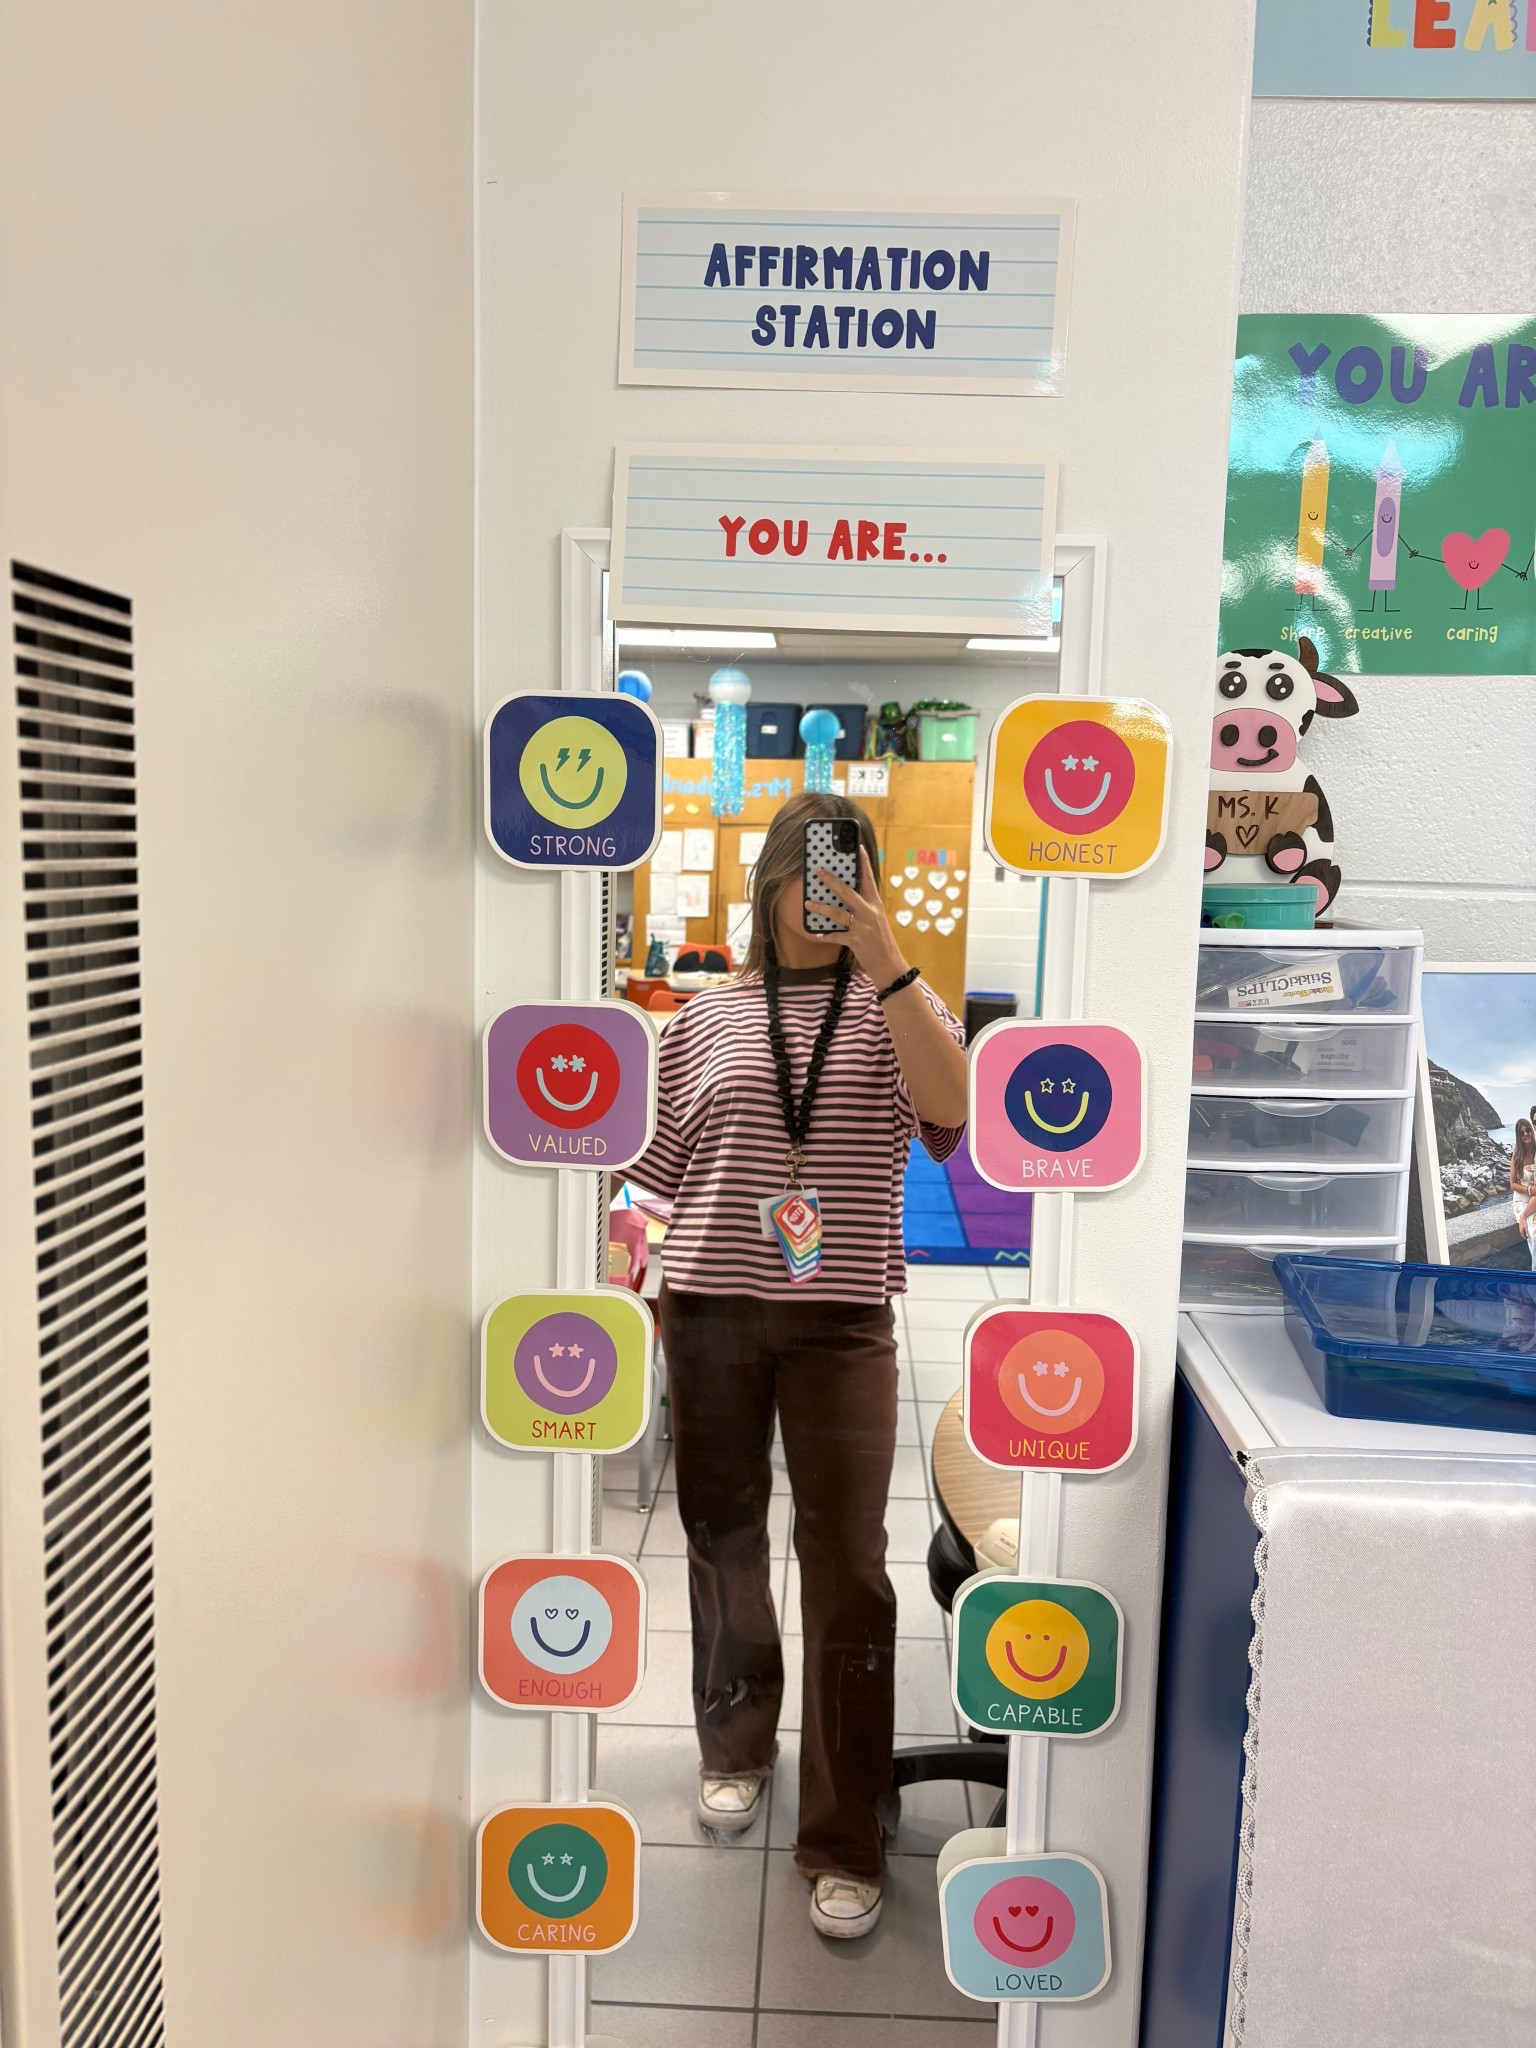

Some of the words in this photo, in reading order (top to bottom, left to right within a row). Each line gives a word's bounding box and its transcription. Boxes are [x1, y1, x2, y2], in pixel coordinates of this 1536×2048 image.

[1366, 0, 1536, 51] LEA
[703, 242, 990, 292] AFFIRMATION
[751, 304, 937, 350] STATION
[1287, 342, 1429, 409] YOU
[718, 515, 809, 557] YOU
[826, 518, 948, 564] ARE...
[1344, 625, 1413, 642] creative
[1446, 625, 1498, 643] caring
[1217, 795, 1256, 819] MS.
[1264, 795, 1280, 821] K
[529, 834, 617, 858] STRONG
[1028, 841, 1118, 865] HONEST
[1236, 971, 1332, 998] StikkiCLIPS
[528, 1133, 608, 1156] VALUED
[1022, 1158, 1094, 1179] BRAVE
[531, 1419, 598, 1441] SMART
[1008, 1438, 1091, 1461] UNIQUE
[518, 1679, 602, 1700] ENOUGH
[987, 1703, 1083, 1726] CAPABLE
[517, 1923, 597, 1943] CARING
[995, 1973, 1063, 1992] LOVED
